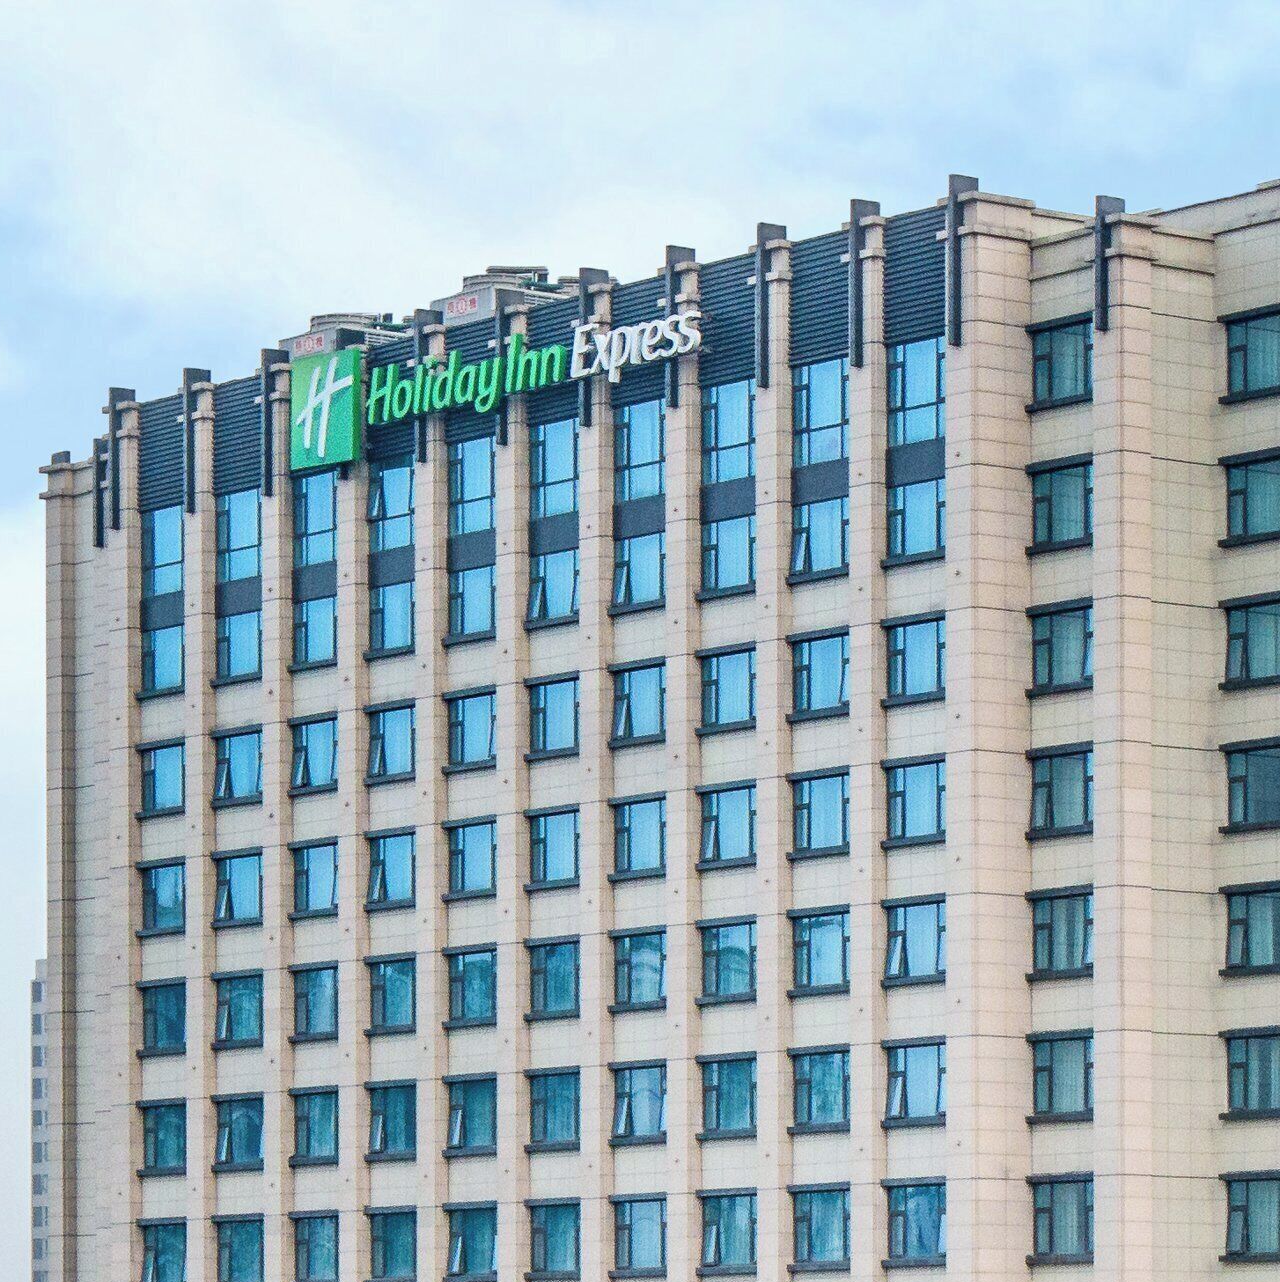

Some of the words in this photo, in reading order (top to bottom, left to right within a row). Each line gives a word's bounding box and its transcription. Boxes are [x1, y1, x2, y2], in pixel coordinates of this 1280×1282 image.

[367, 349, 502, 425] Holiday
[505, 333, 568, 394] Inn
[570, 310, 702, 383] Express
